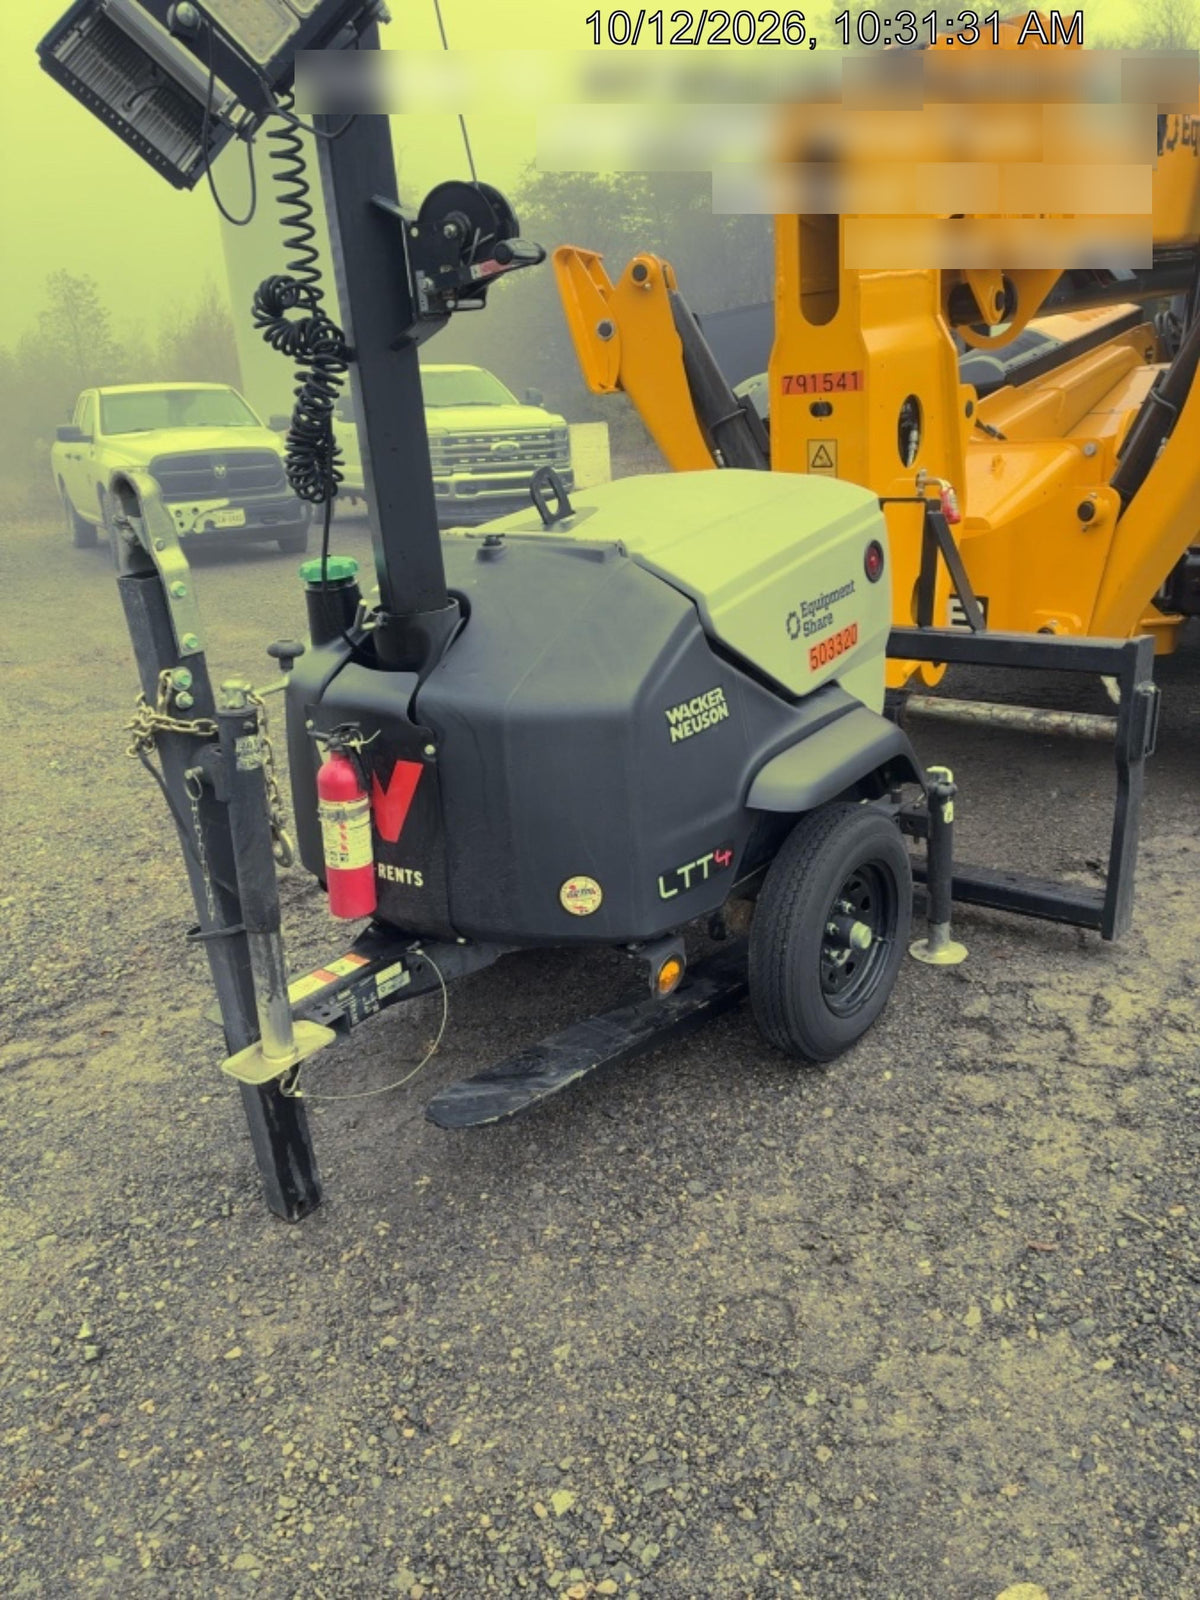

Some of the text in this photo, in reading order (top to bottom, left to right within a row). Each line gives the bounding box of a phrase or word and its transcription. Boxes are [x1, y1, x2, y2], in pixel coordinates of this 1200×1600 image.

[783, 371, 858, 394] 791541
[800, 579, 856, 619] Equipment
[803, 612, 833, 638] Share
[810, 623, 857, 671] 503320
[664, 686, 726, 725] WACKER
[670, 702, 730, 743] NEUSON
